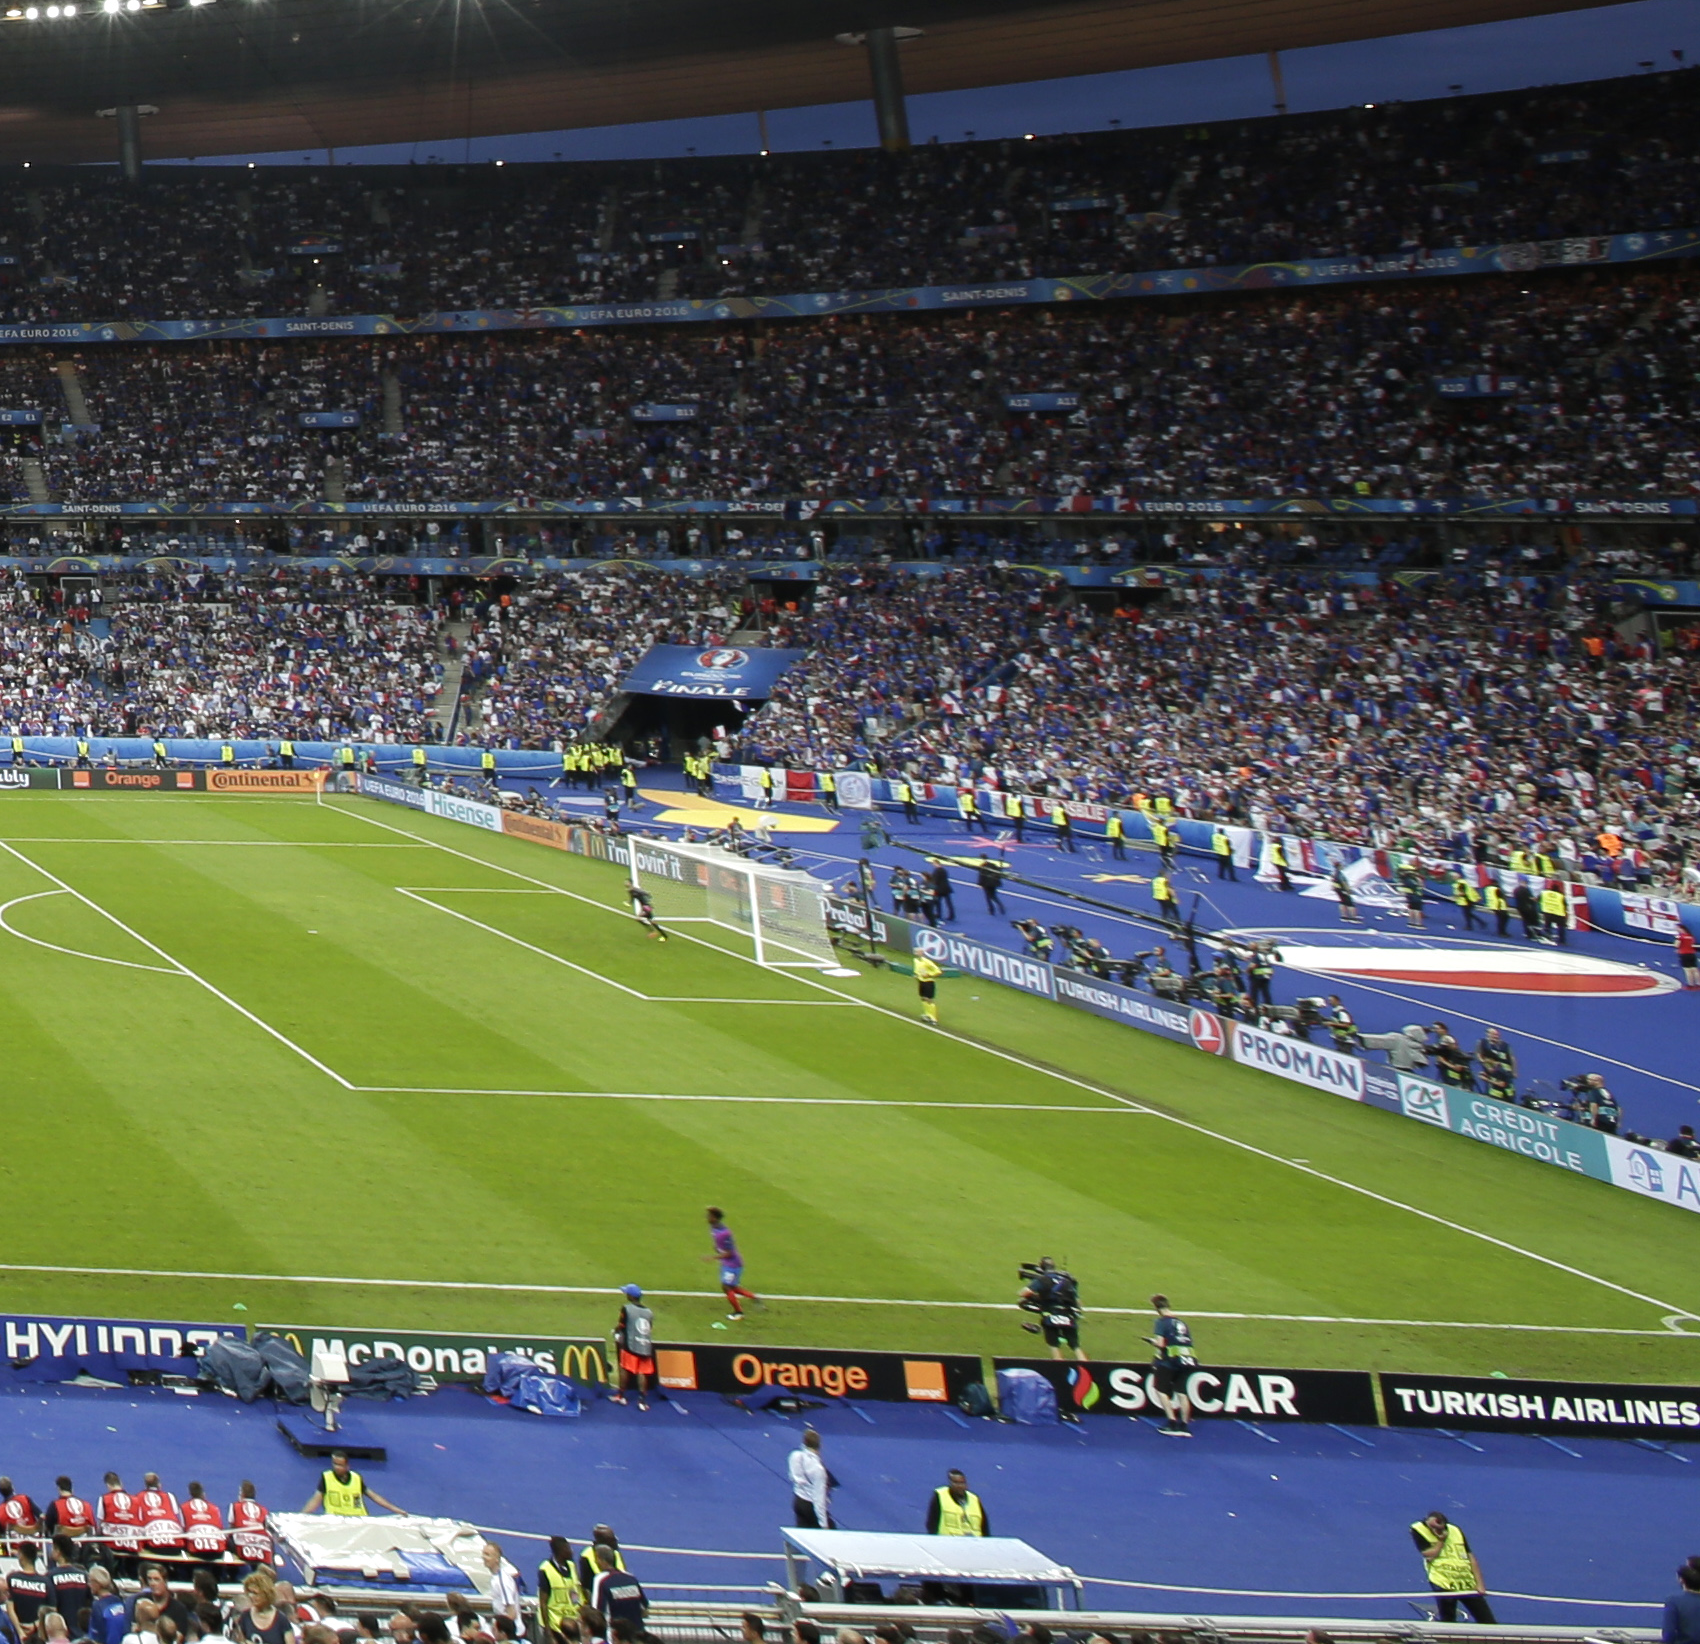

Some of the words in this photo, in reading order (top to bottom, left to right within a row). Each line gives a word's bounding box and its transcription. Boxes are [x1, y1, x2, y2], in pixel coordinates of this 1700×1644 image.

[1315, 263, 1359, 277] UEFA
[942, 287, 1027, 302] SAINT-DENIS
[580, 309, 614, 321] UEFA
[616, 307, 651, 319] EURO
[653, 306, 688, 317] 2016
[19, 329, 49, 339] EURO
[51, 328, 79, 338] 2016
[286, 320, 353, 332] SAINT-DENIS
[61, 504, 121, 513] SAINT-DENIS
[362, 503, 393, 513] UEFA
[395, 503, 424, 513] EURO
[426, 503, 456, 513] 2016
[1143, 501, 1184, 512] EURO
[1186, 501, 1223, 512] 2016
[652, 682, 751, 697] FINALE
[105, 772, 161, 789] Orange
[212, 771, 301, 789] Continental
[364, 779, 385, 795] UEFA
[384, 784, 405, 801] EURO
[406, 788, 424, 804] 2016
[432, 791, 495, 829] Hisense
[607, 838, 630, 866] i'm
[637, 852, 668, 877] ovin'
[669, 855, 683, 881] it
[947, 937, 1051, 995] HYUNDAI
[1055, 976, 1120, 1015] TURKISH
[1120, 990, 1190, 1036] AIRLINES
[1239, 1028, 1361, 1093] PROMAN
[1470, 1099, 1559, 1142] CRÉDIT
[1458, 1117, 1584, 1174] AGRICOLE
[5, 1320, 235, 1359] HYUNDA
[732, 1353, 870, 1396] Orange
[1394, 1387, 1548, 1420] TURKISH
[1551, 1396, 1700, 1427] AIRLINES
[10, 1578, 47, 1594] FRANCE
[53, 1572, 86, 1586] FRANCE
